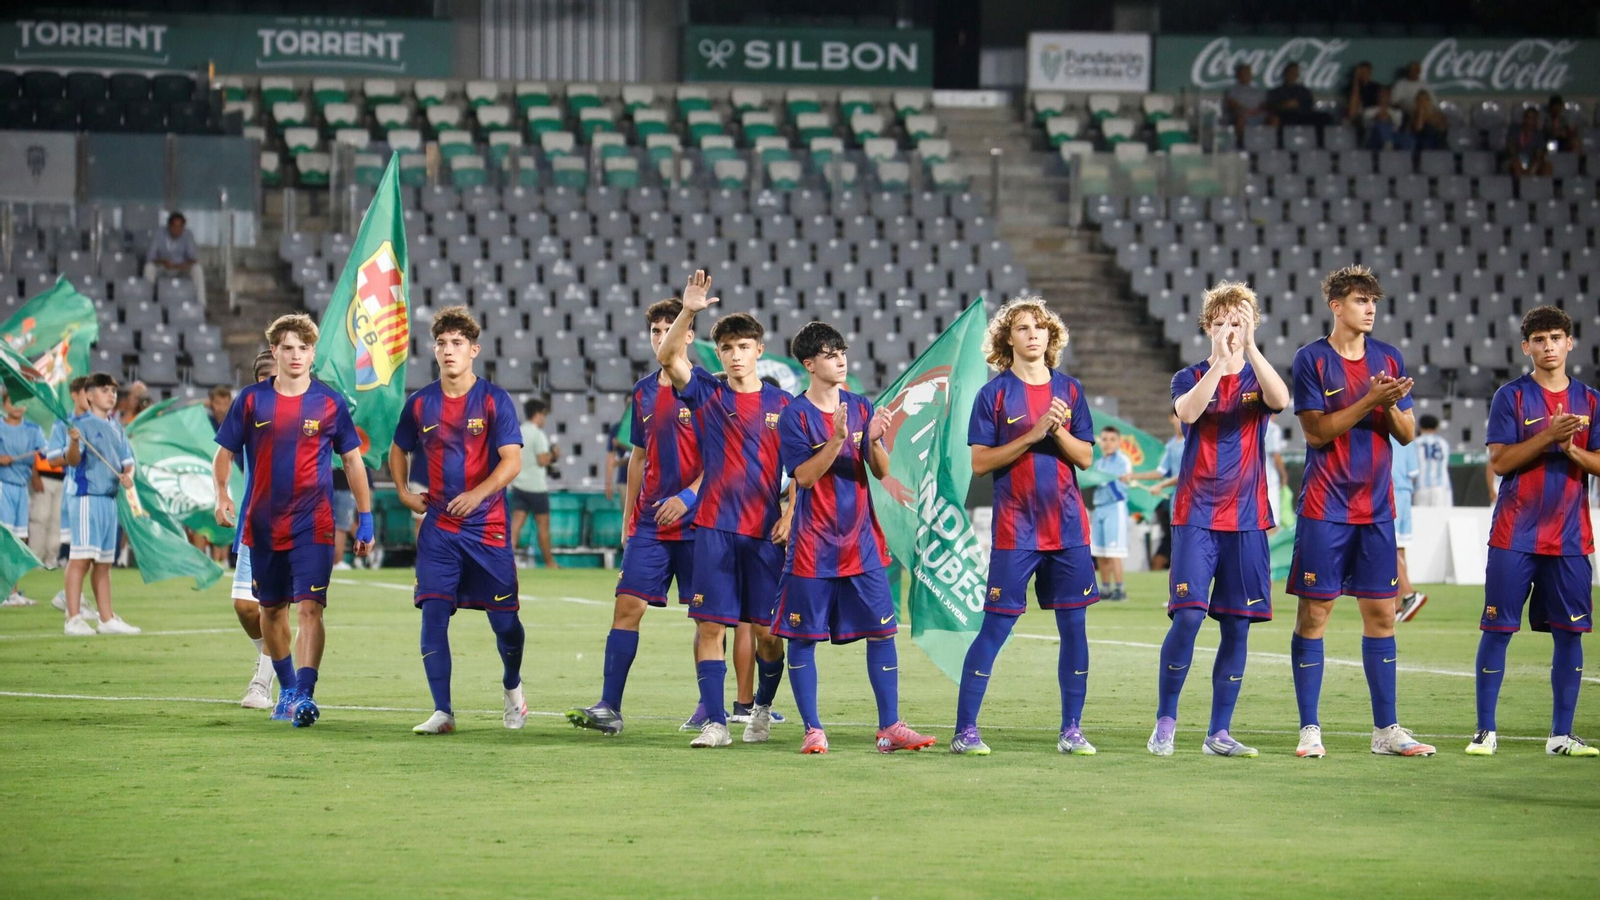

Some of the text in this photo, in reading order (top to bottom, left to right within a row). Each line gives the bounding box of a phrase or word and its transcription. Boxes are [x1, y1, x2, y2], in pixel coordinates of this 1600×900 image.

[16, 21, 168, 52] TORRENT
[257, 29, 404, 60] TORRENT
[743, 39, 919, 72] SILBON
[1419, 37, 1580, 90] Coca-Cola
[943, 598, 969, 626] JUVENIL
